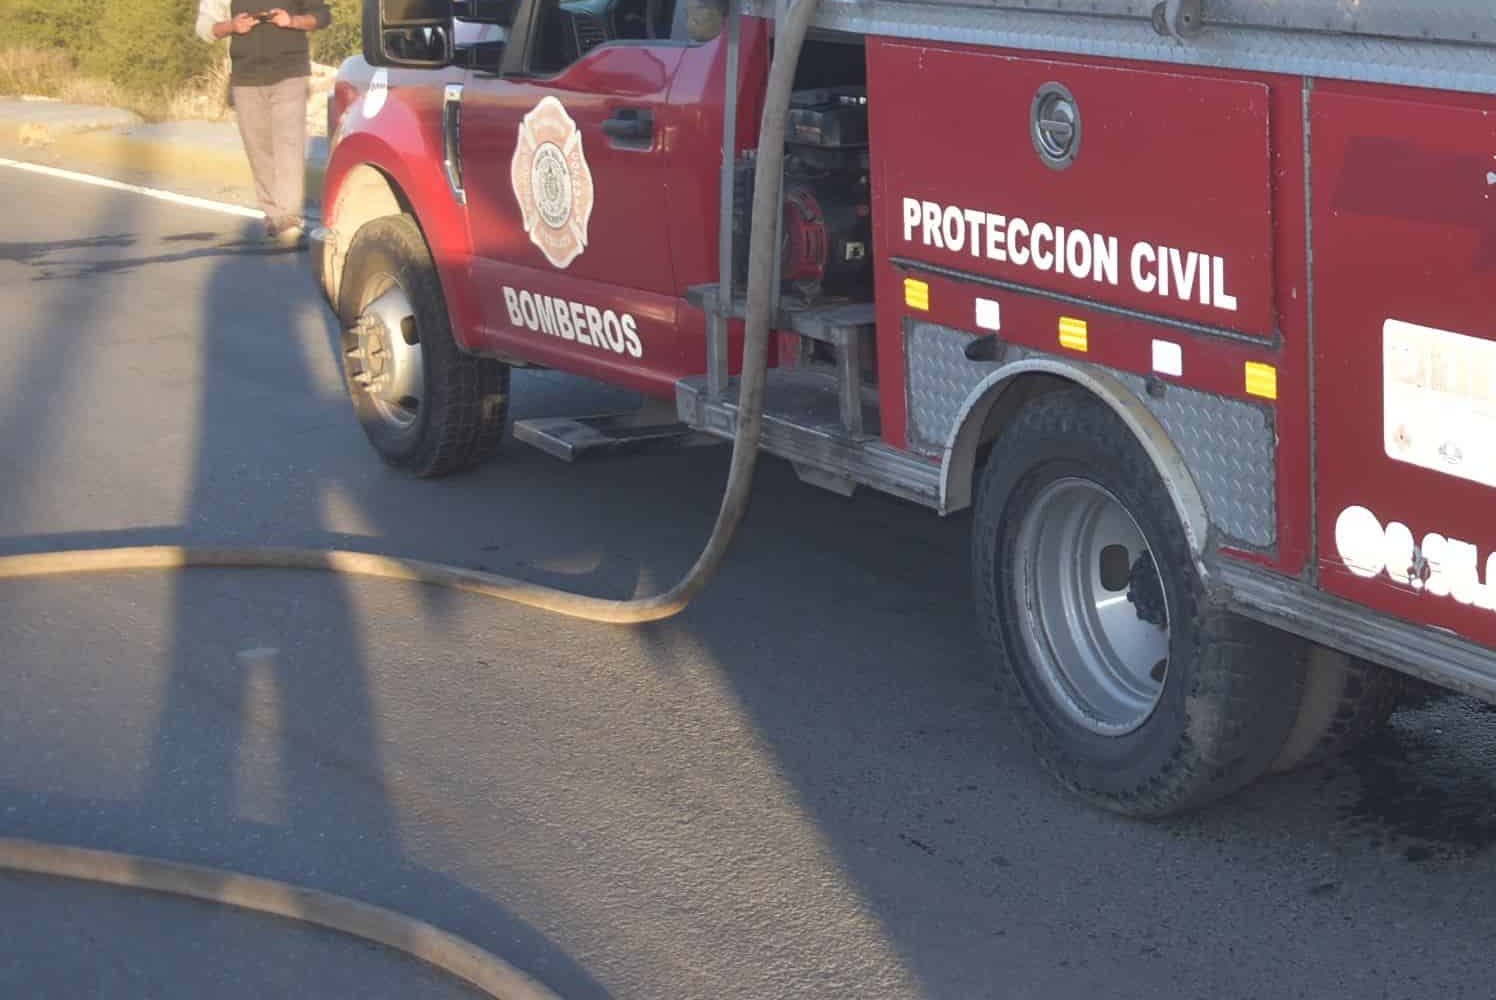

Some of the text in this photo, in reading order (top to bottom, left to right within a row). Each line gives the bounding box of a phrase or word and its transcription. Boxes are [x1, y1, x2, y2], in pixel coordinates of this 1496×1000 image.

[903, 197, 1238, 311] PROTECCION CIVIL
[502, 285, 643, 358] BOMBEROS
